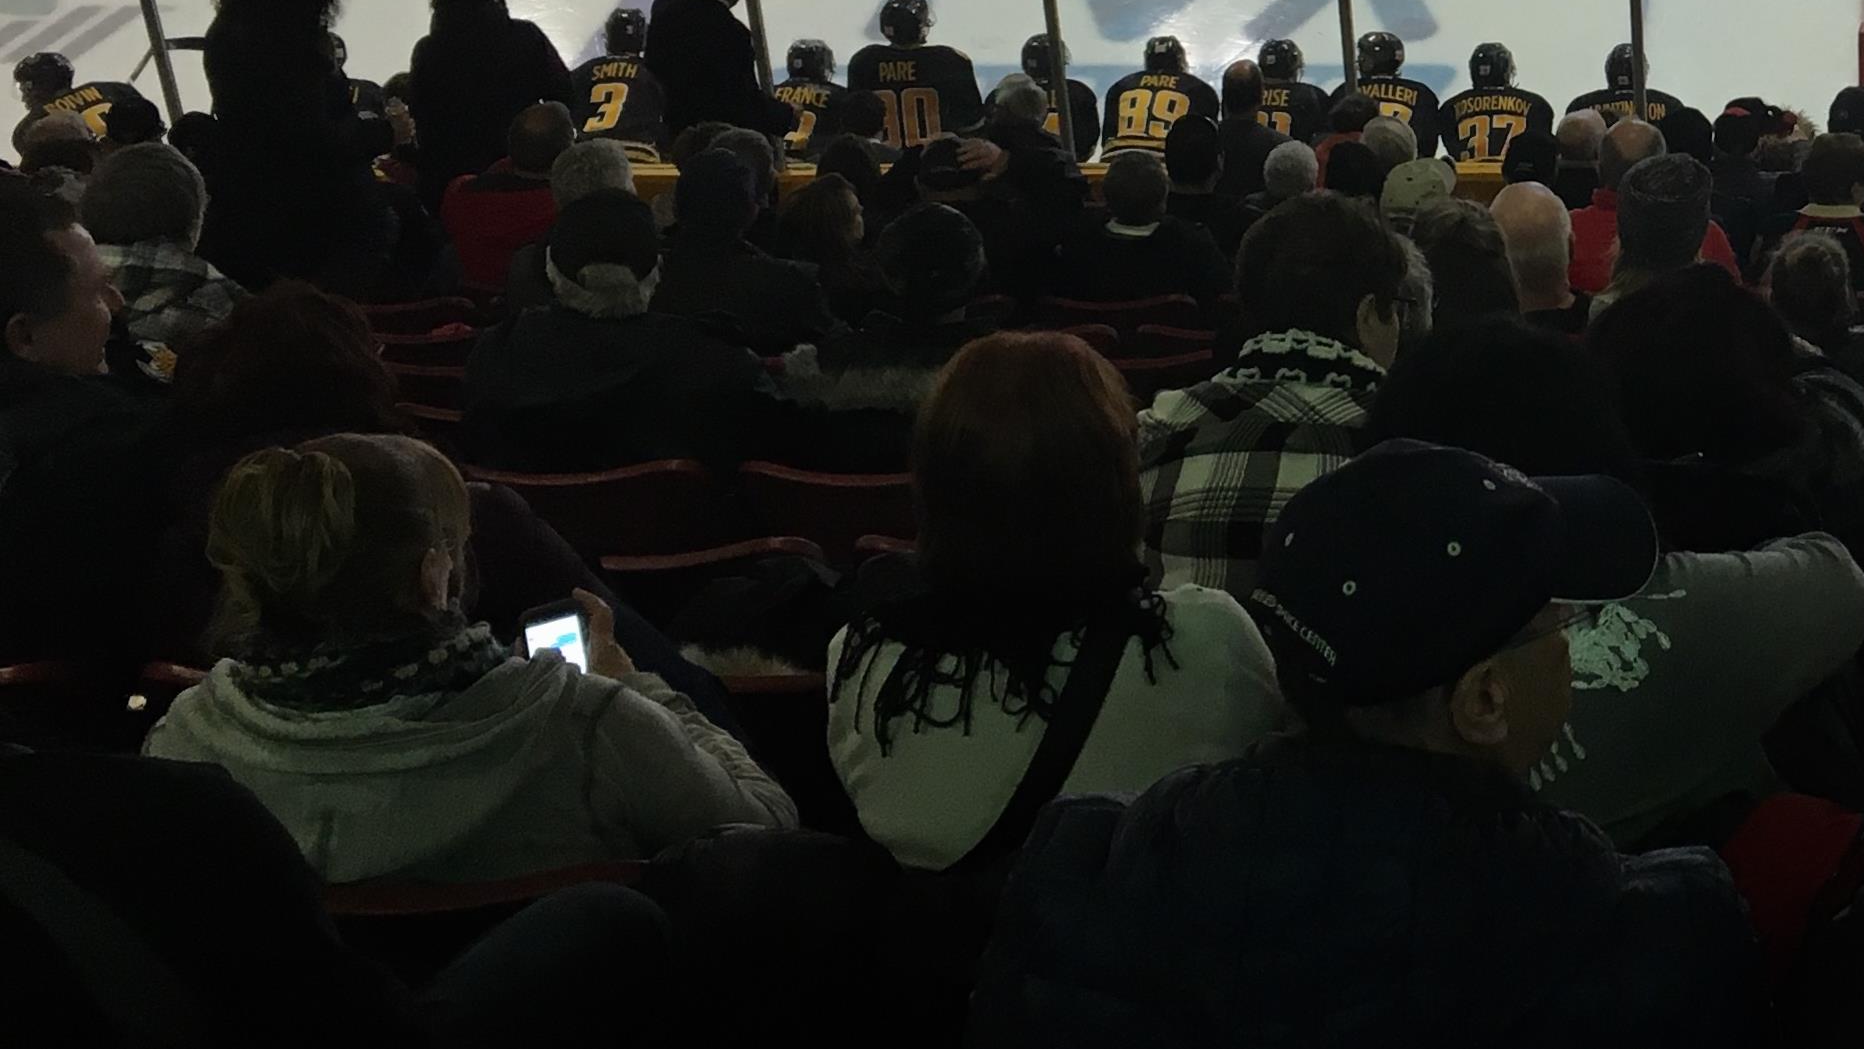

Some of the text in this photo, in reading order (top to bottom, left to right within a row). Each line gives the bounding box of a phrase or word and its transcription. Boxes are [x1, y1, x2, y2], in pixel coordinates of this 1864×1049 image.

[591, 62, 639, 81] SMITH
[878, 60, 917, 82] PARE
[1140, 74, 1180, 89] PARE
[583, 82, 630, 134] 3
[1117, 87, 1191, 140] 89
[1457, 113, 1527, 162] 37
